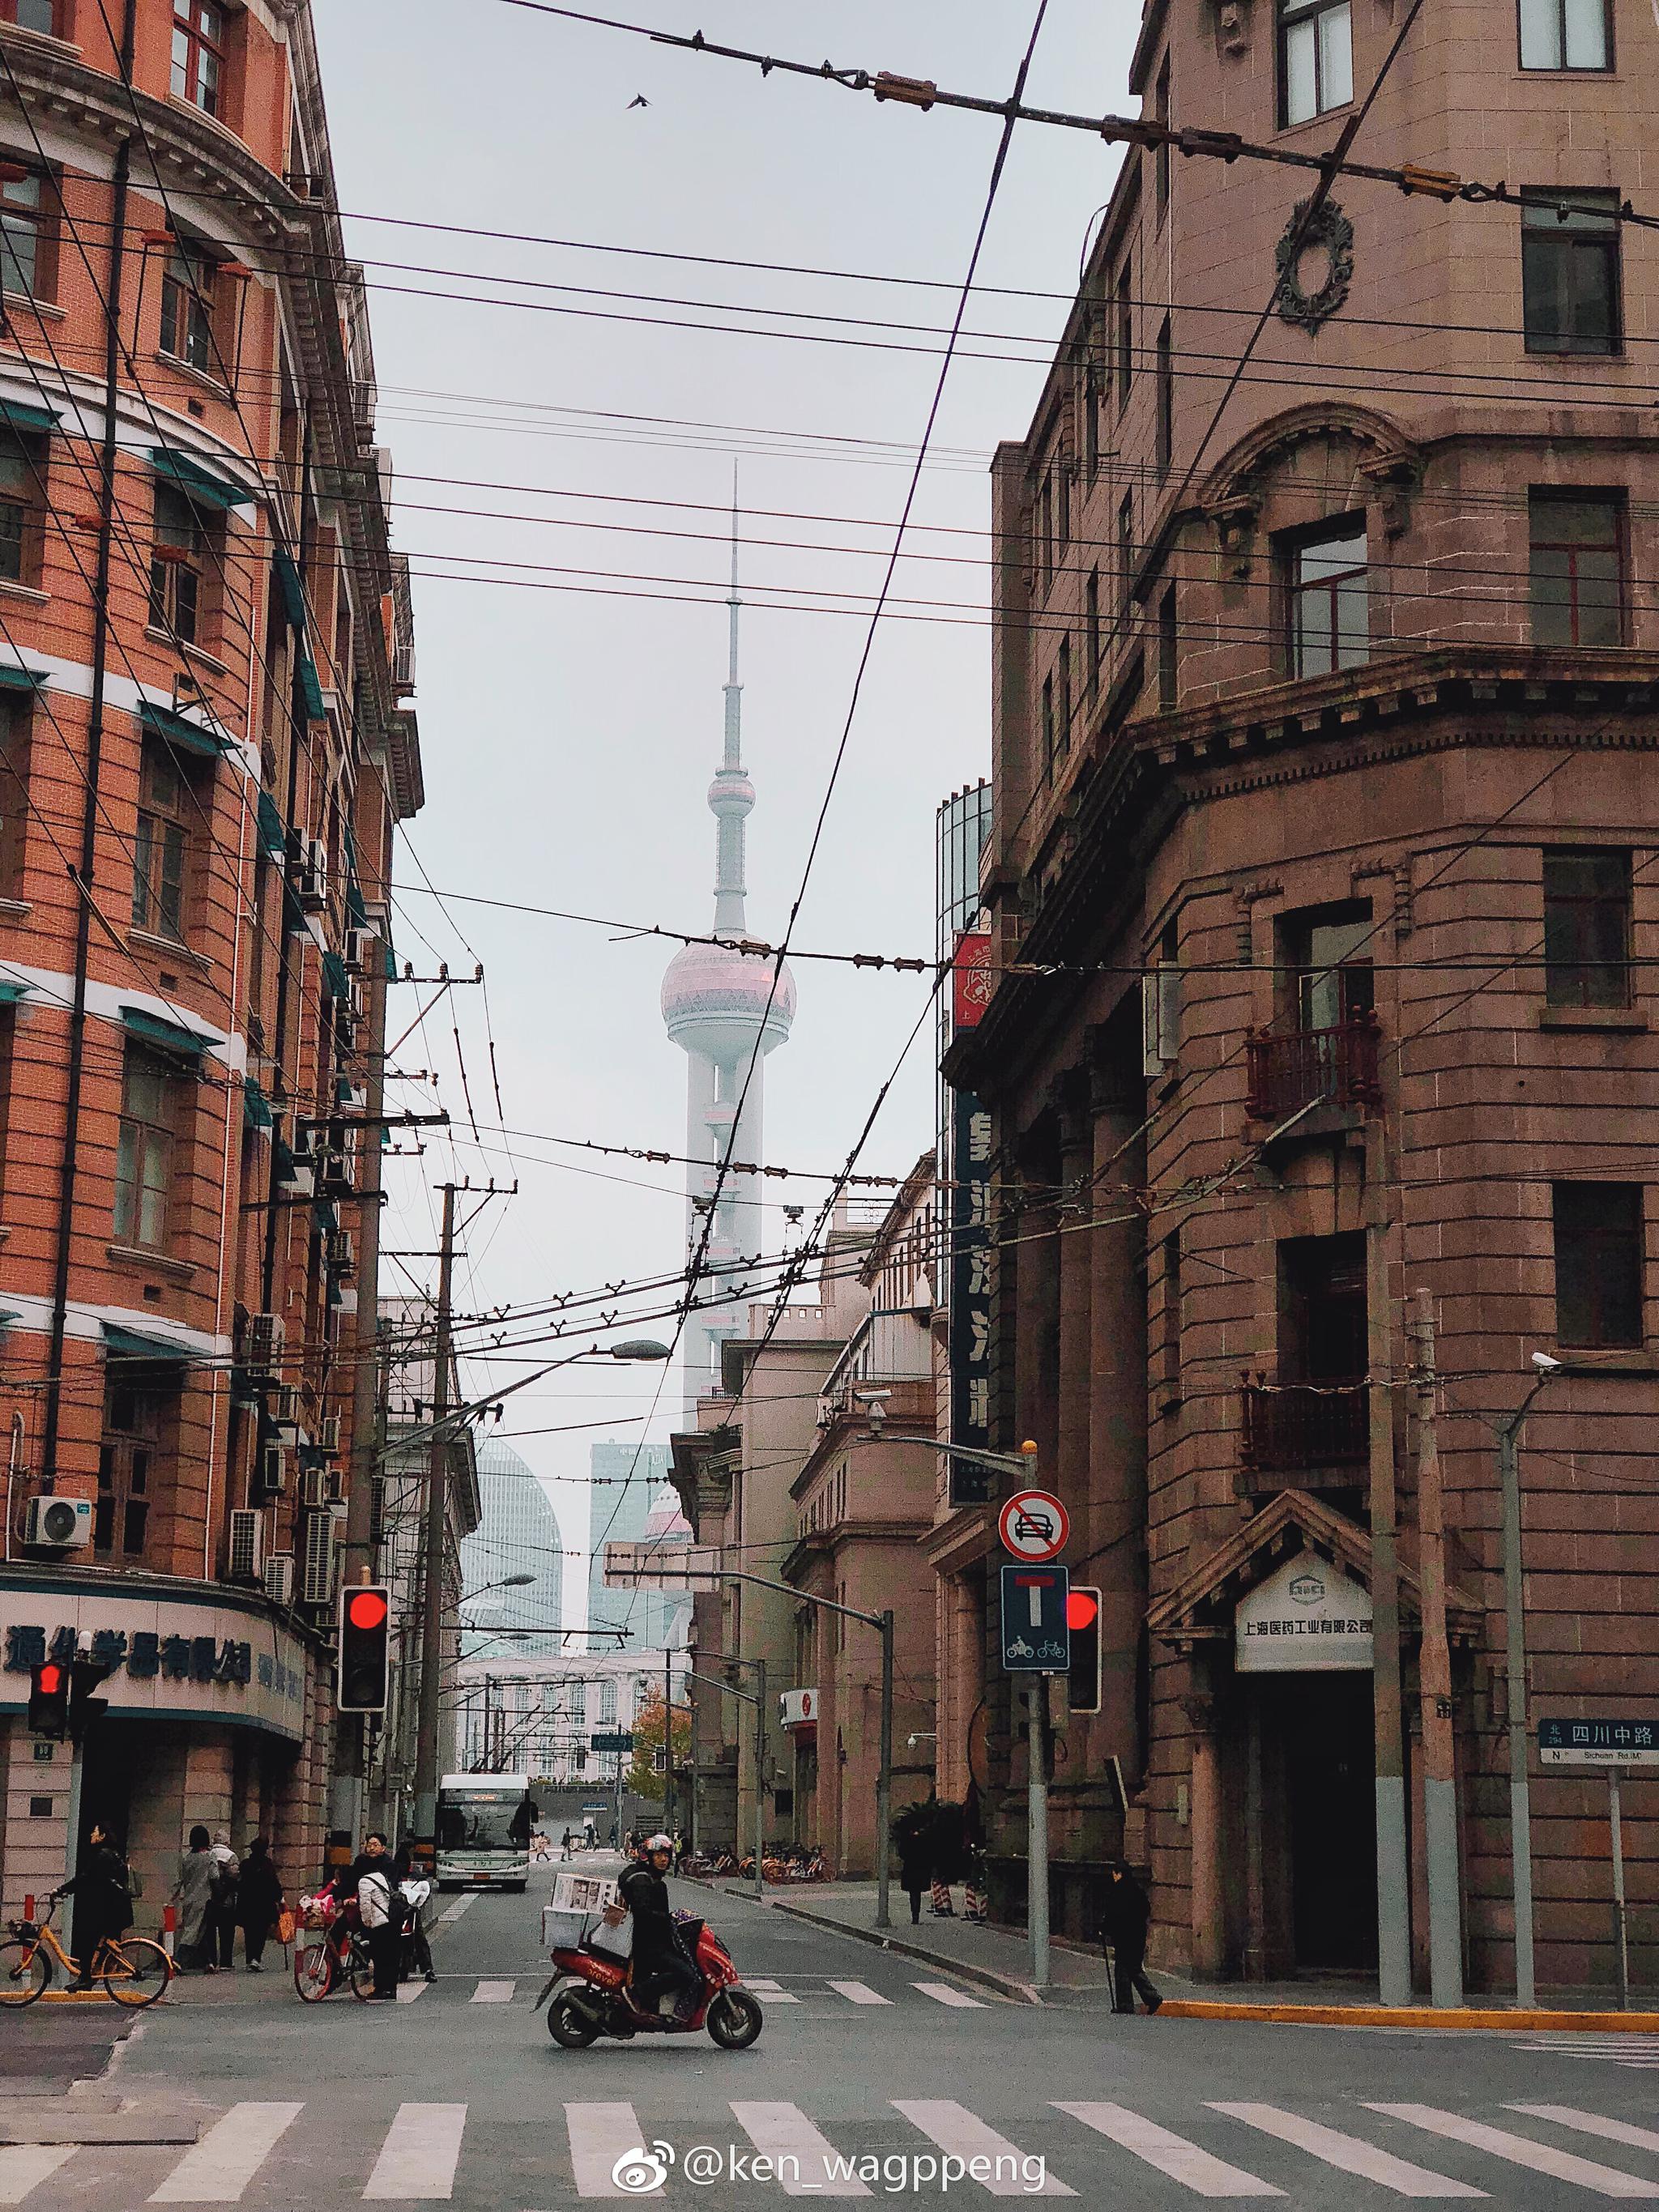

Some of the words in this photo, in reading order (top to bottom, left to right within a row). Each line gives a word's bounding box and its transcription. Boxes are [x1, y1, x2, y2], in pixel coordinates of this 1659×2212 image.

[1244, 1620, 1373, 1636] 上海医药工业有限公司
[1550, 1724, 1561, 1735] 北
[1572, 1725, 1653, 1745] 四川中路
[1552, 1751, 1561, 1760] N
